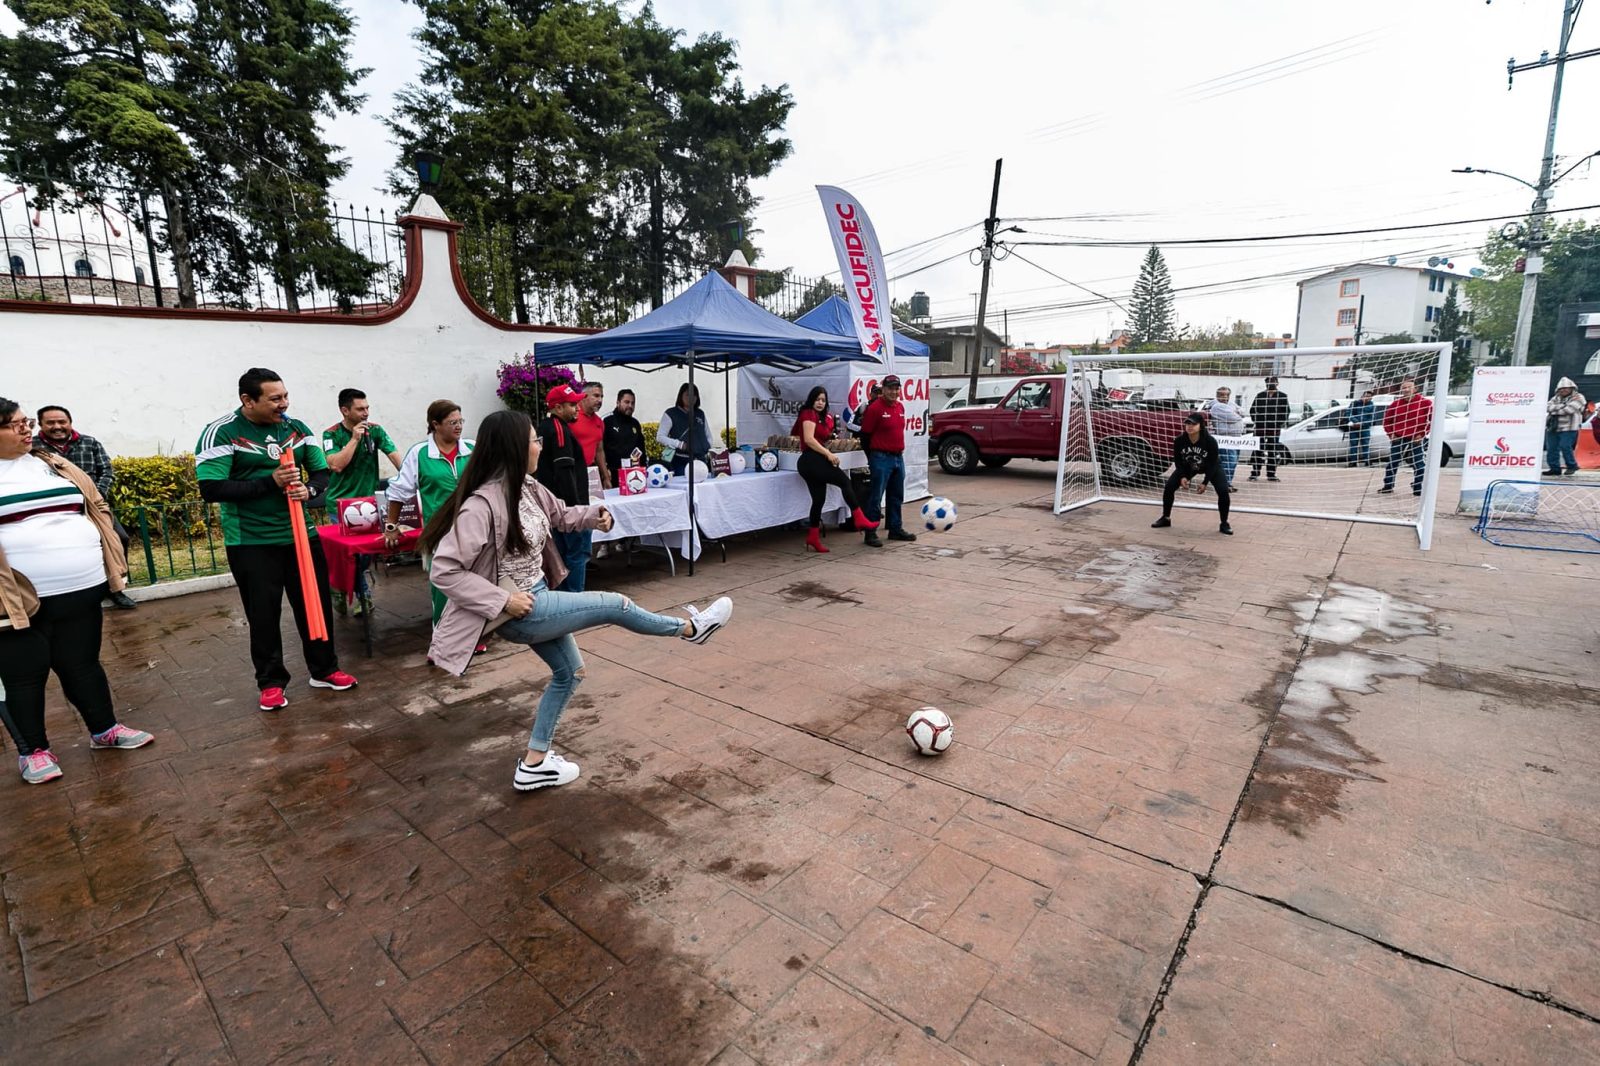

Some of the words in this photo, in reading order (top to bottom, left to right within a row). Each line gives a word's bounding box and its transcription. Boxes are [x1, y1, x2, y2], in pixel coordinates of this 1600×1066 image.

[836, 204, 879, 329] IMCUFIDEC
[866, 378, 930, 401] CCAL
[1469, 456, 1536, 466] IMCUFIDEC
